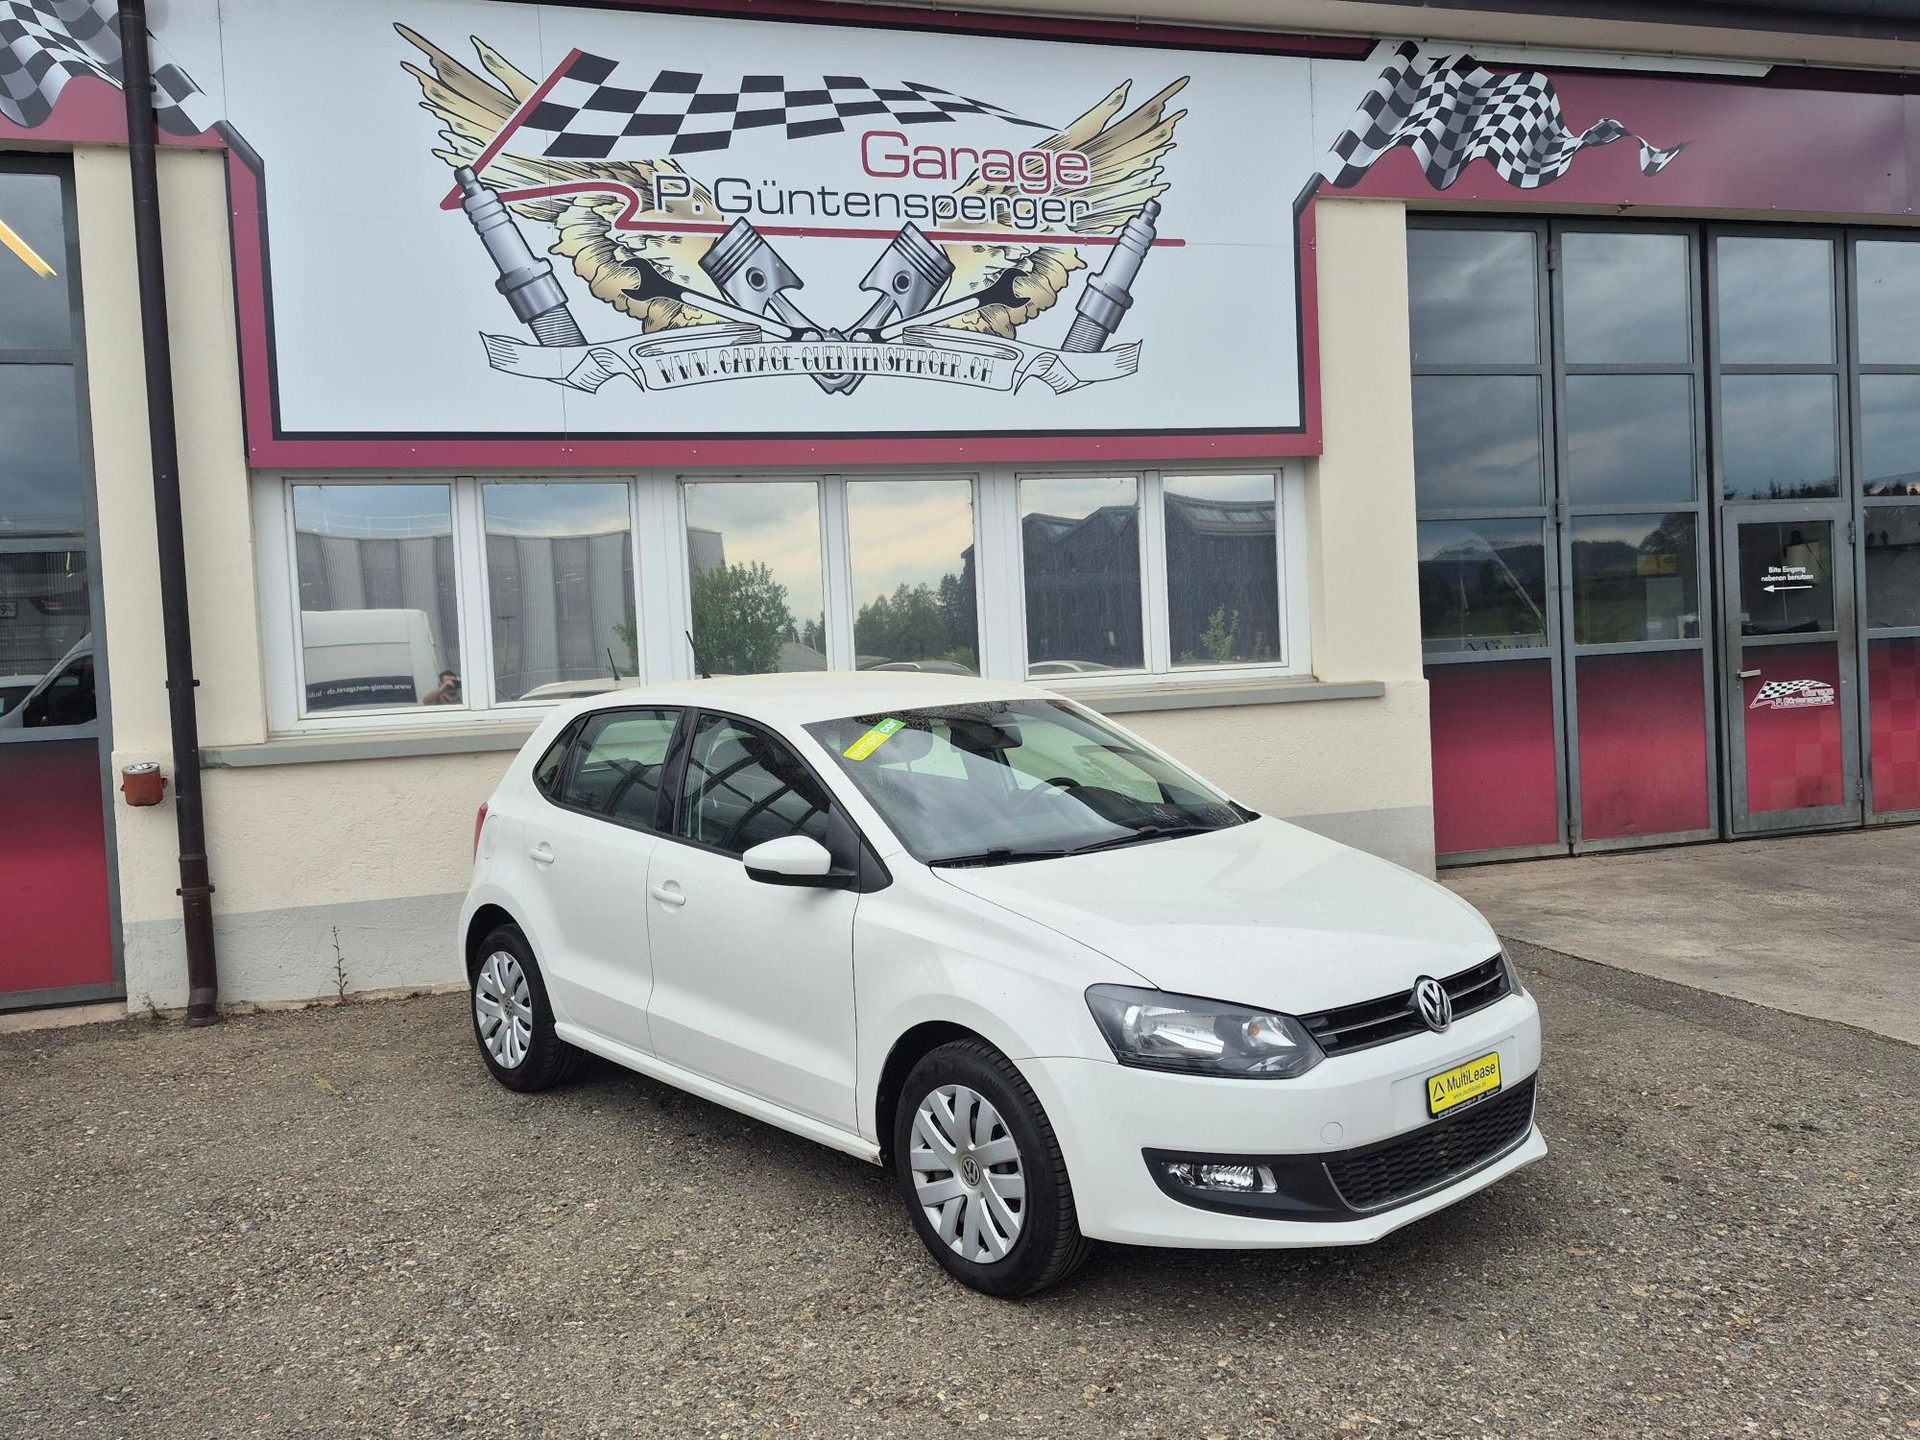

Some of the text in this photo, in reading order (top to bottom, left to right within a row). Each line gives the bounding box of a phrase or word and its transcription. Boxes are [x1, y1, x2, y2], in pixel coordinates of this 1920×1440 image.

[860, 129, 1089, 195] Garage
[655, 174, 1090, 230] P. Güntensperger
[655, 345, 995, 384] WWW.GARAGE-GUENTENSPERGER.CH
[1782, 565, 1806, 574] Eingang
[1446, 1063, 1496, 1092] MultiLease
